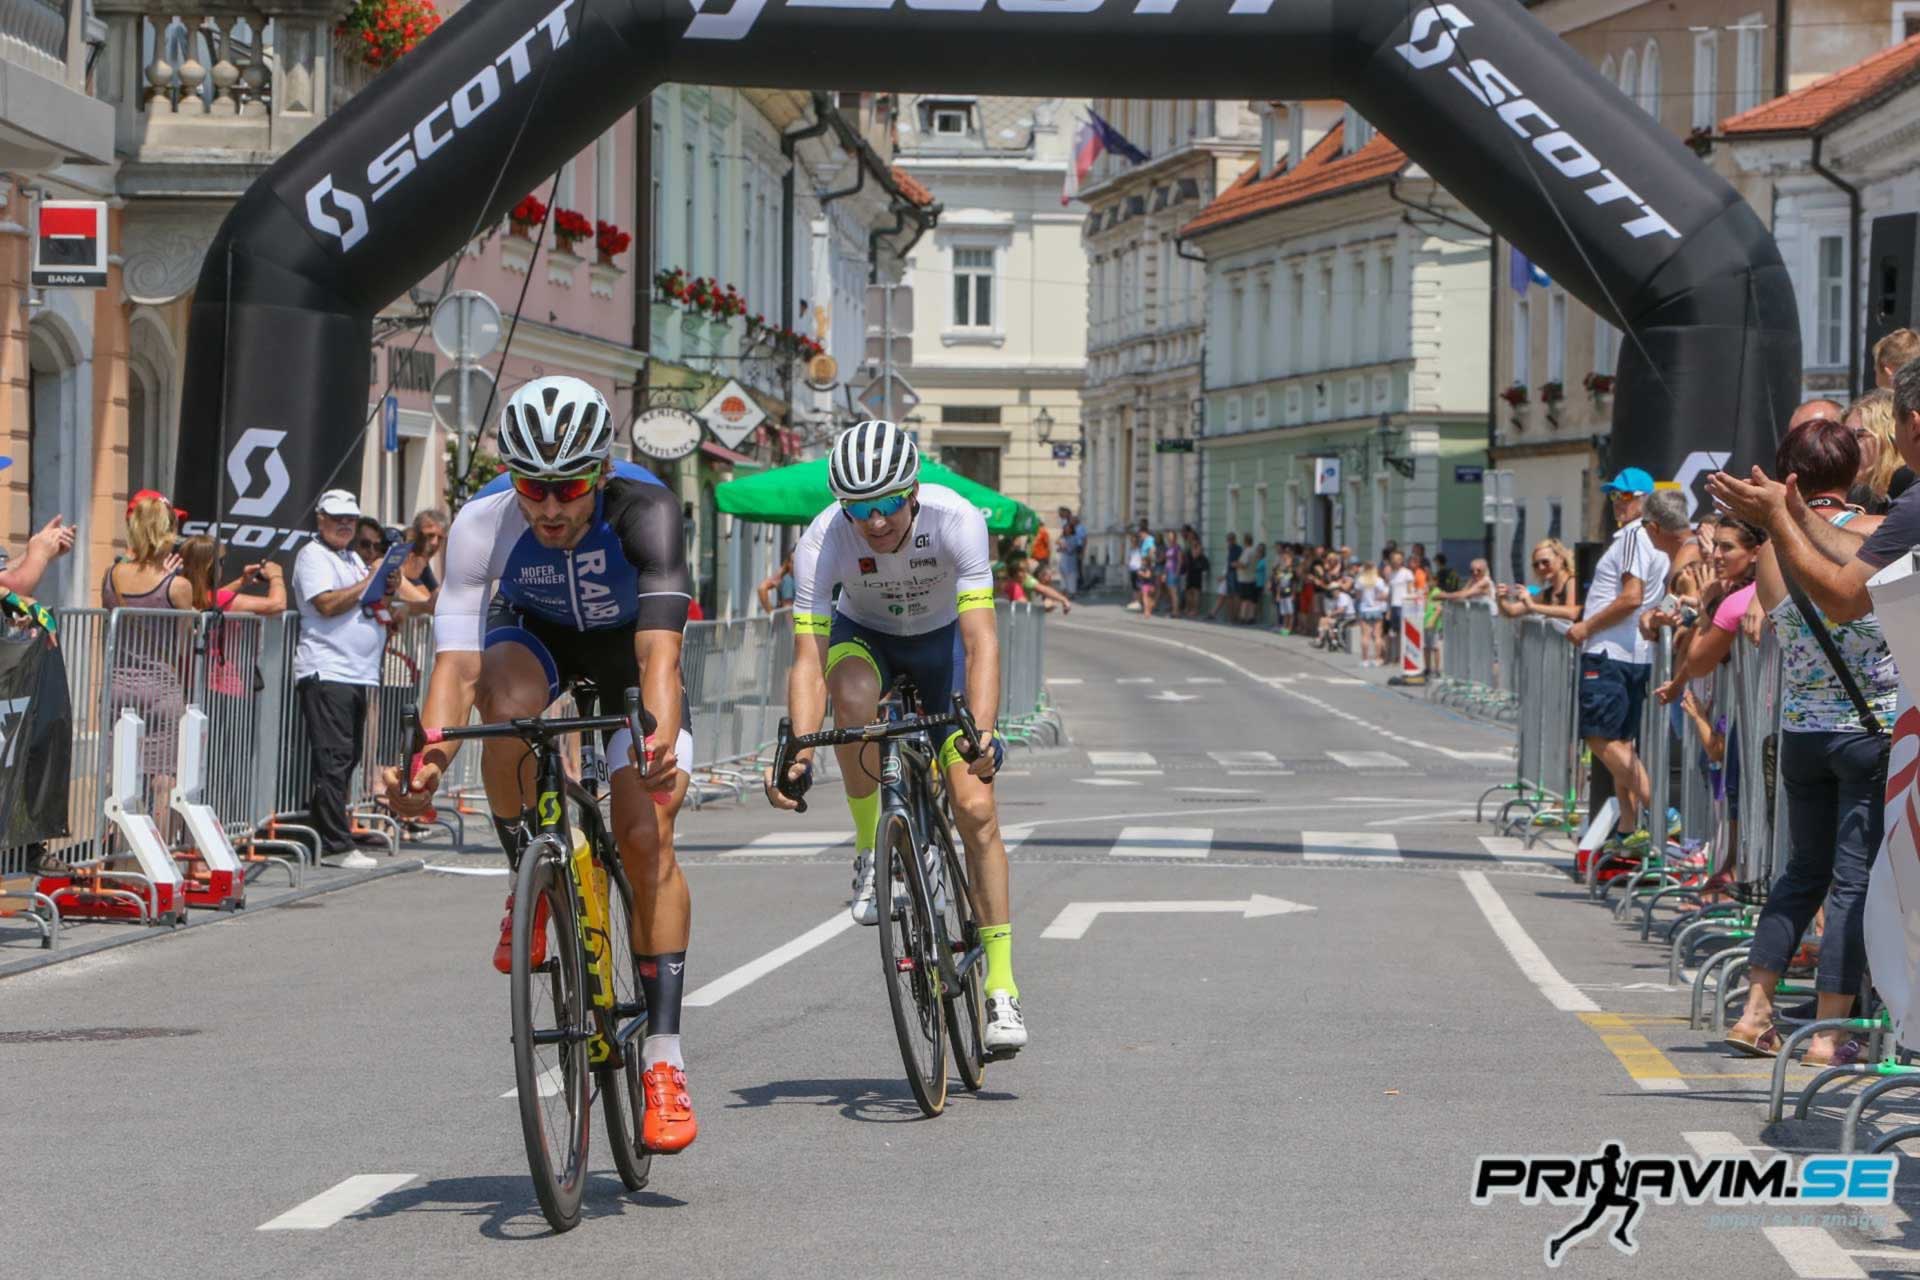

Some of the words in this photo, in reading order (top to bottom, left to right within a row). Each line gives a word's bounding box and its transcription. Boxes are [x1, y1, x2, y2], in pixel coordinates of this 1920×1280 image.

[367, 0, 575, 203] SCOTT
[1447, 57, 1682, 241] SCOTT
[48, 275, 85, 284] BANKA
[183, 521, 318, 551] SCOT
[521, 565, 555, 578] HOFER
